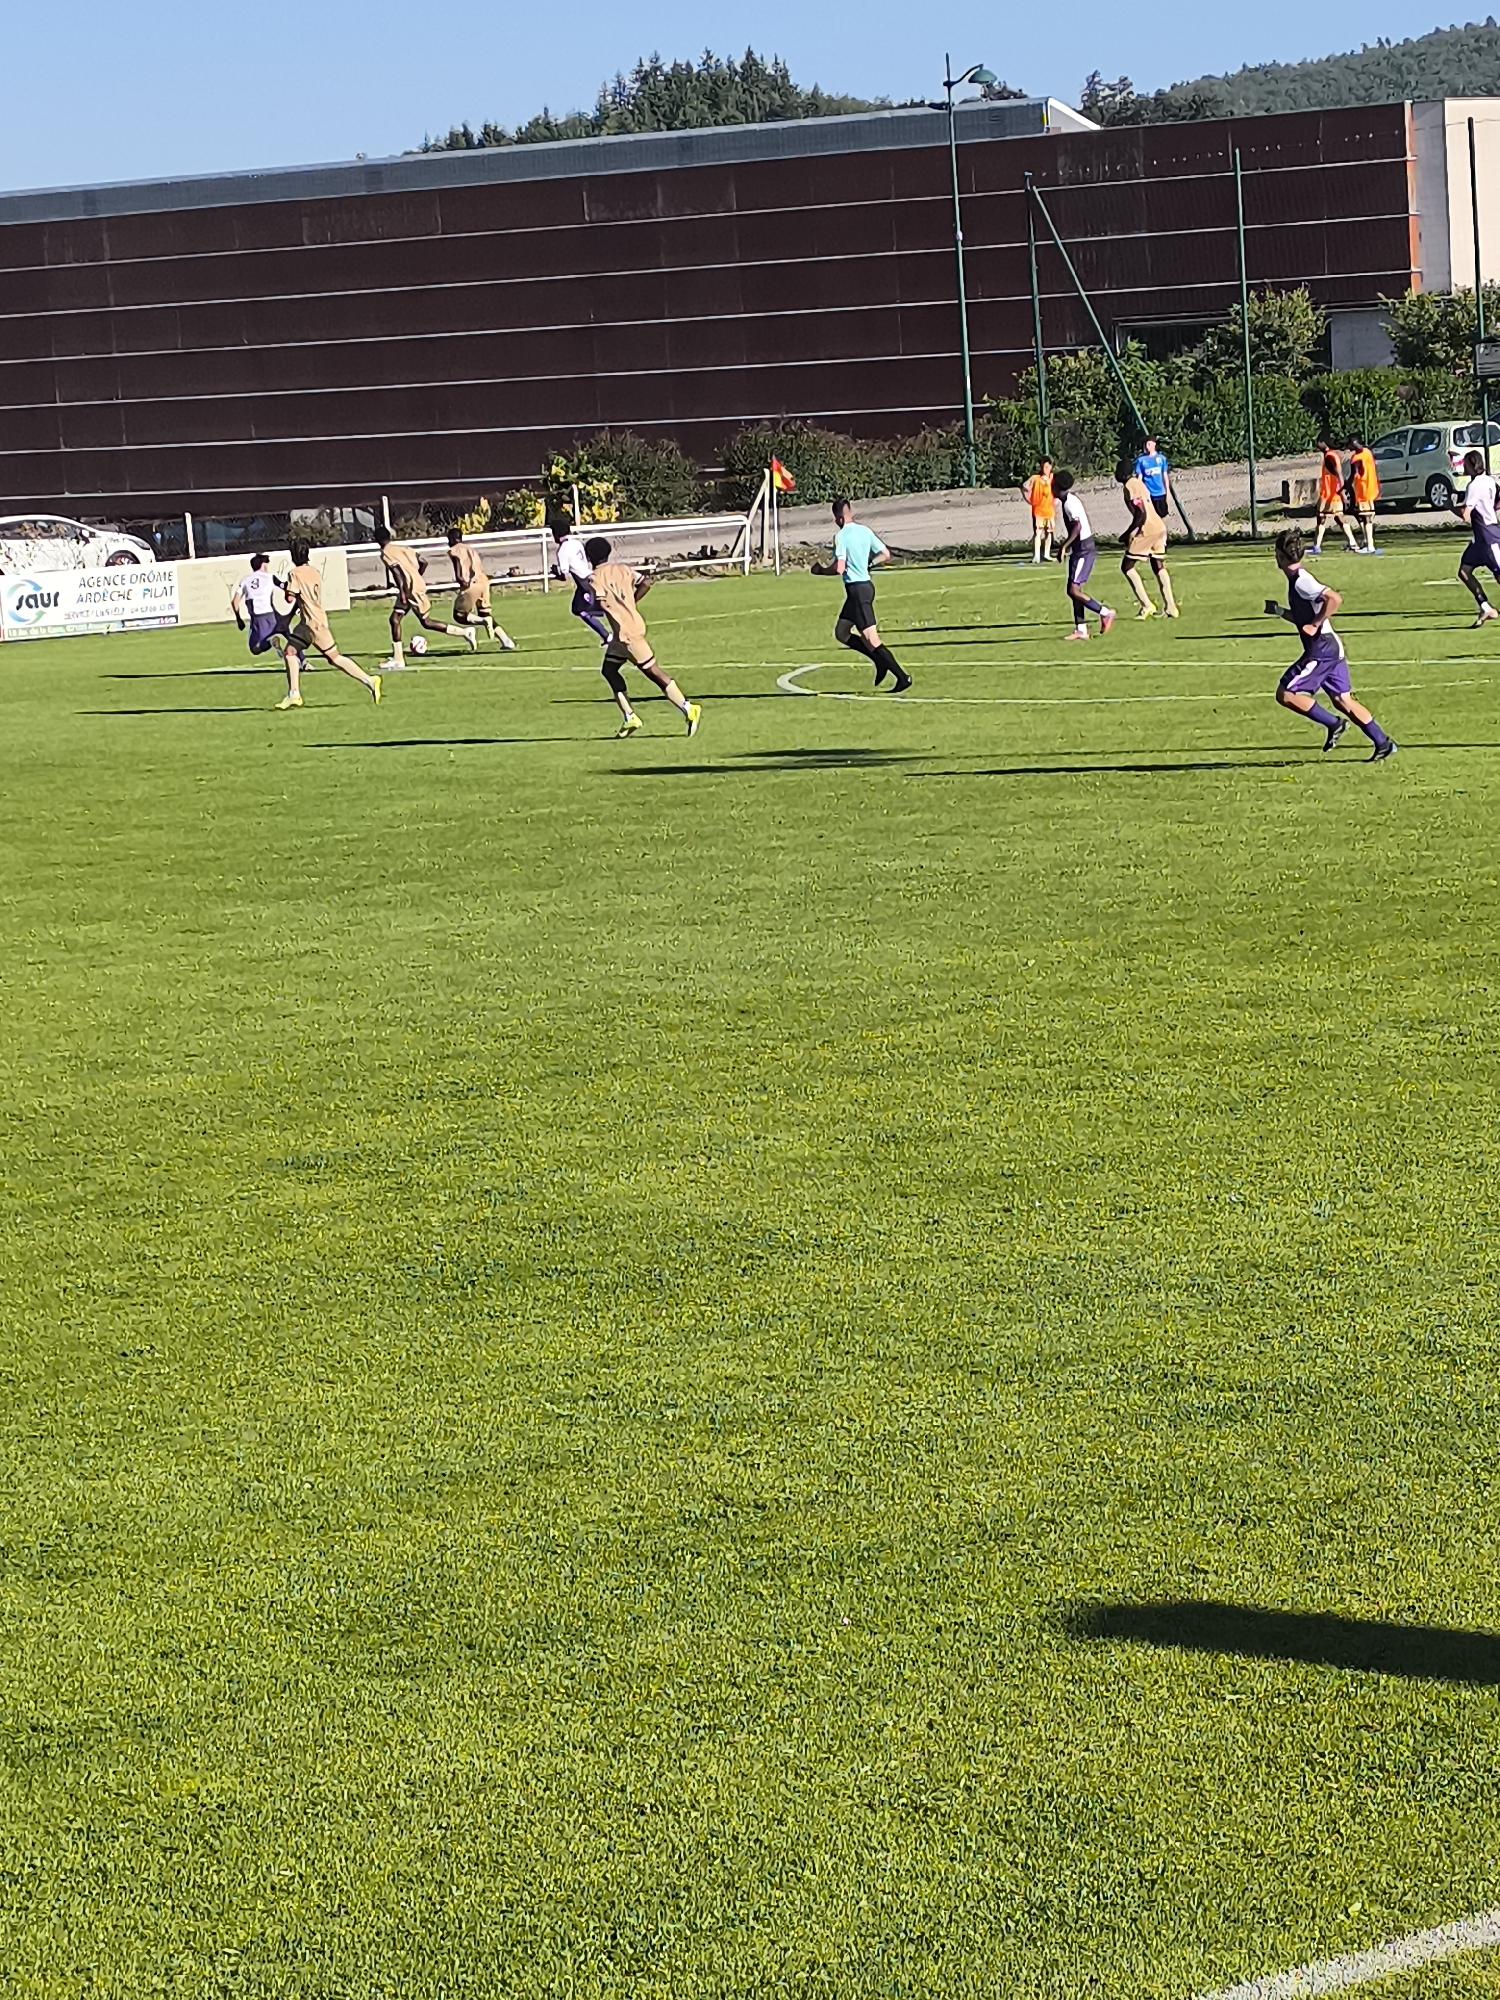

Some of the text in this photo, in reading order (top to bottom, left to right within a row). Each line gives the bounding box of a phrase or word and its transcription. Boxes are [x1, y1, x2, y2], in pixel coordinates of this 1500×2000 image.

[78, 569, 174, 588] AGENCE DRÔME
[15, 591, 60, 611] saur
[76, 585, 175, 604] ARDÈCHE PILAT
